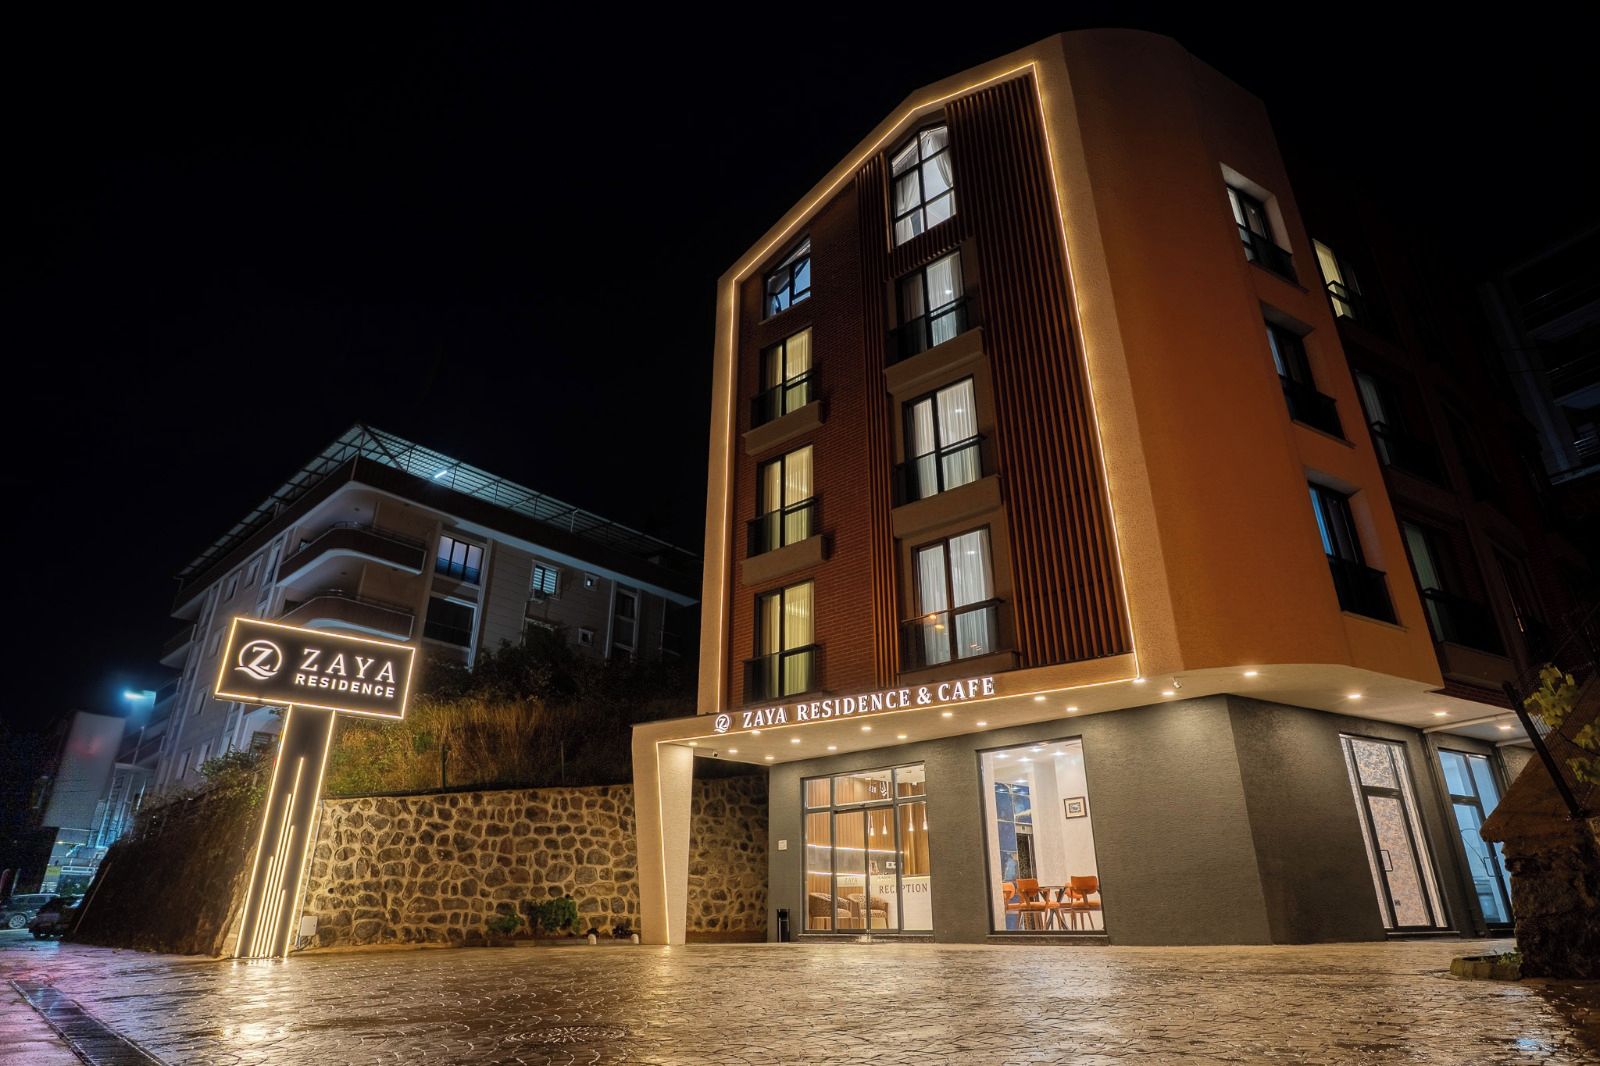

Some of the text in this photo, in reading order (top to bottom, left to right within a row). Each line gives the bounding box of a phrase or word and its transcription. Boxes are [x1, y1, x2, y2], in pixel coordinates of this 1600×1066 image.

[300, 648, 396, 684] ZAYA
[294, 672, 396, 698] RESIDENCE
[743, 676, 995, 729] ZAYA RESIDENCE & CAFE
